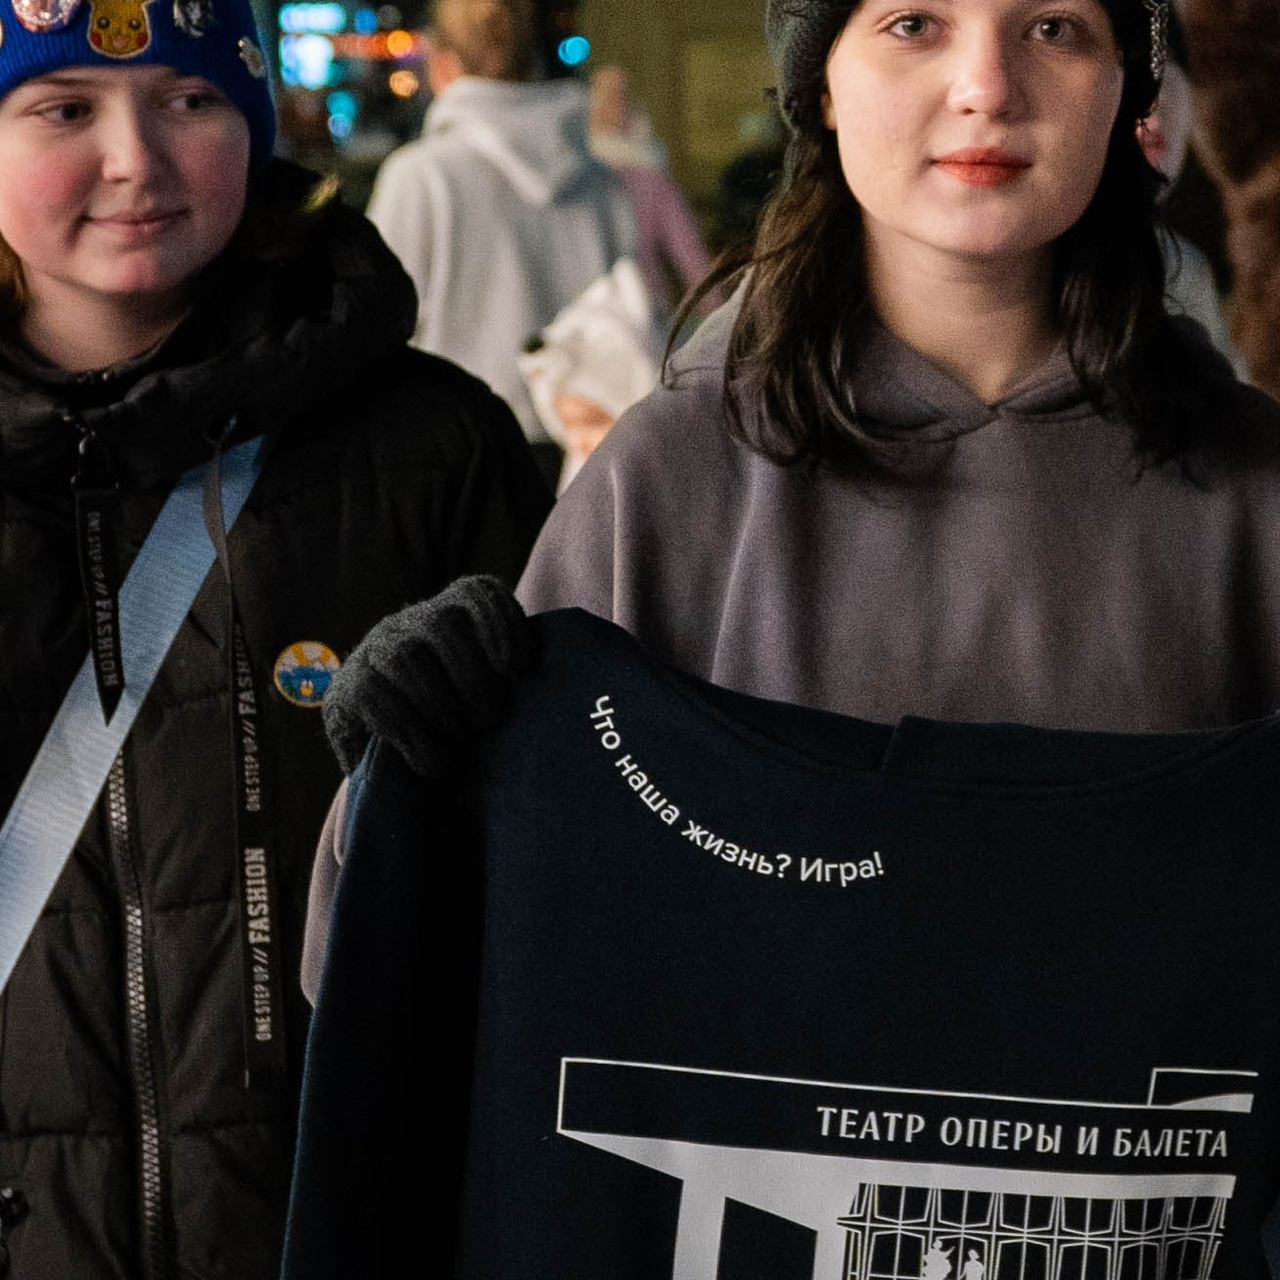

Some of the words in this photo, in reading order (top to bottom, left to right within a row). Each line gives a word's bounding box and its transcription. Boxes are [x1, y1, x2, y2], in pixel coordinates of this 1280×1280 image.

[94, 599, 120, 688] FASHION
[244, 754, 260, 786] STEP
[590, 695, 621, 751] Что
[614, 754, 681, 825] наша
[681, 820, 792, 878] жизнь?
[800, 851, 885, 887] Игра!
[244, 847, 271, 944] FASHION
[252, 965, 270, 982] UP
[253, 983, 271, 1015] STEP
[254, 1016, 272, 1041] ONE
[816, 1106, 926, 1144] ТЕАТР
[939, 1116, 1062, 1155] ОПЕРЫ
[1076, 1126, 1098, 1156] И
[1112, 1128, 1228, 1158] БАЛЕТА
